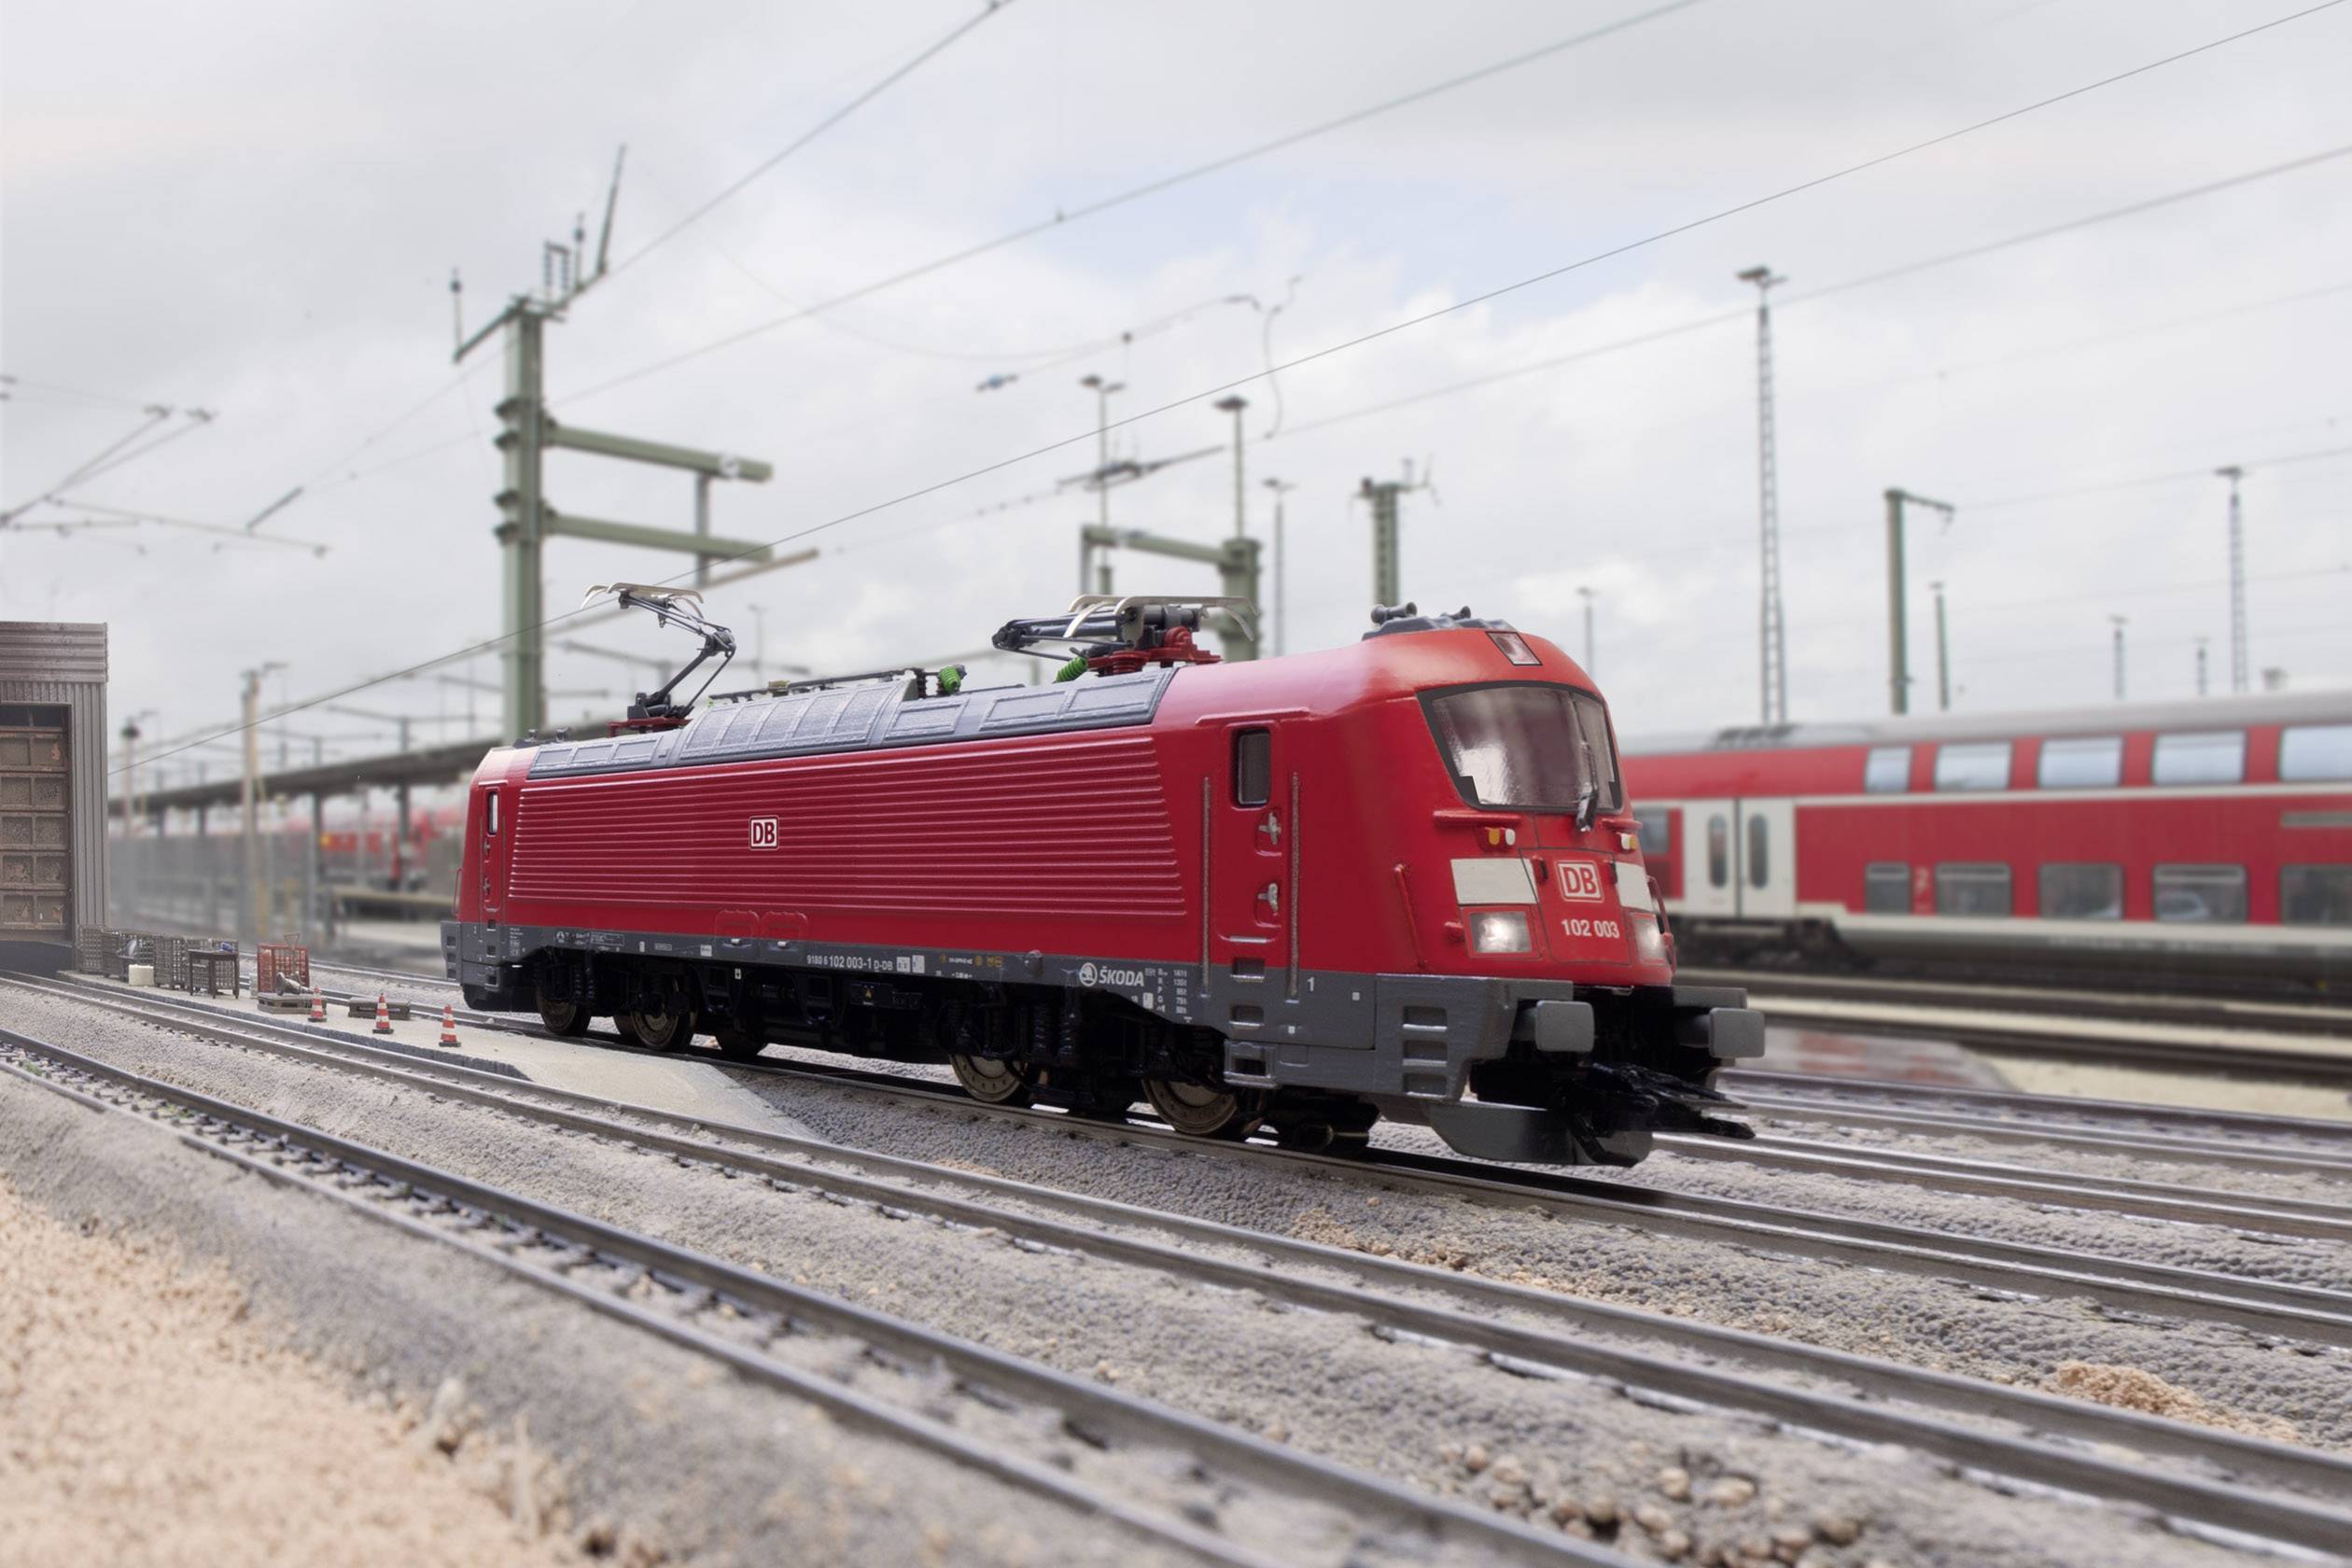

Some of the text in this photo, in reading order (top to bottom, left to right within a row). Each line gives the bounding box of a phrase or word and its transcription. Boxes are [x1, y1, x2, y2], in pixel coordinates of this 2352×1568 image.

[752, 820, 776, 845] DB
[1561, 866, 1598, 895] DB
[1561, 918, 1620, 939] 102 003
[829, 955, 845, 968] 102
[846, 956, 872, 970] 003-1
[1099, 965, 1144, 987] ŠKODA
[1308, 976, 1314, 992] 1
